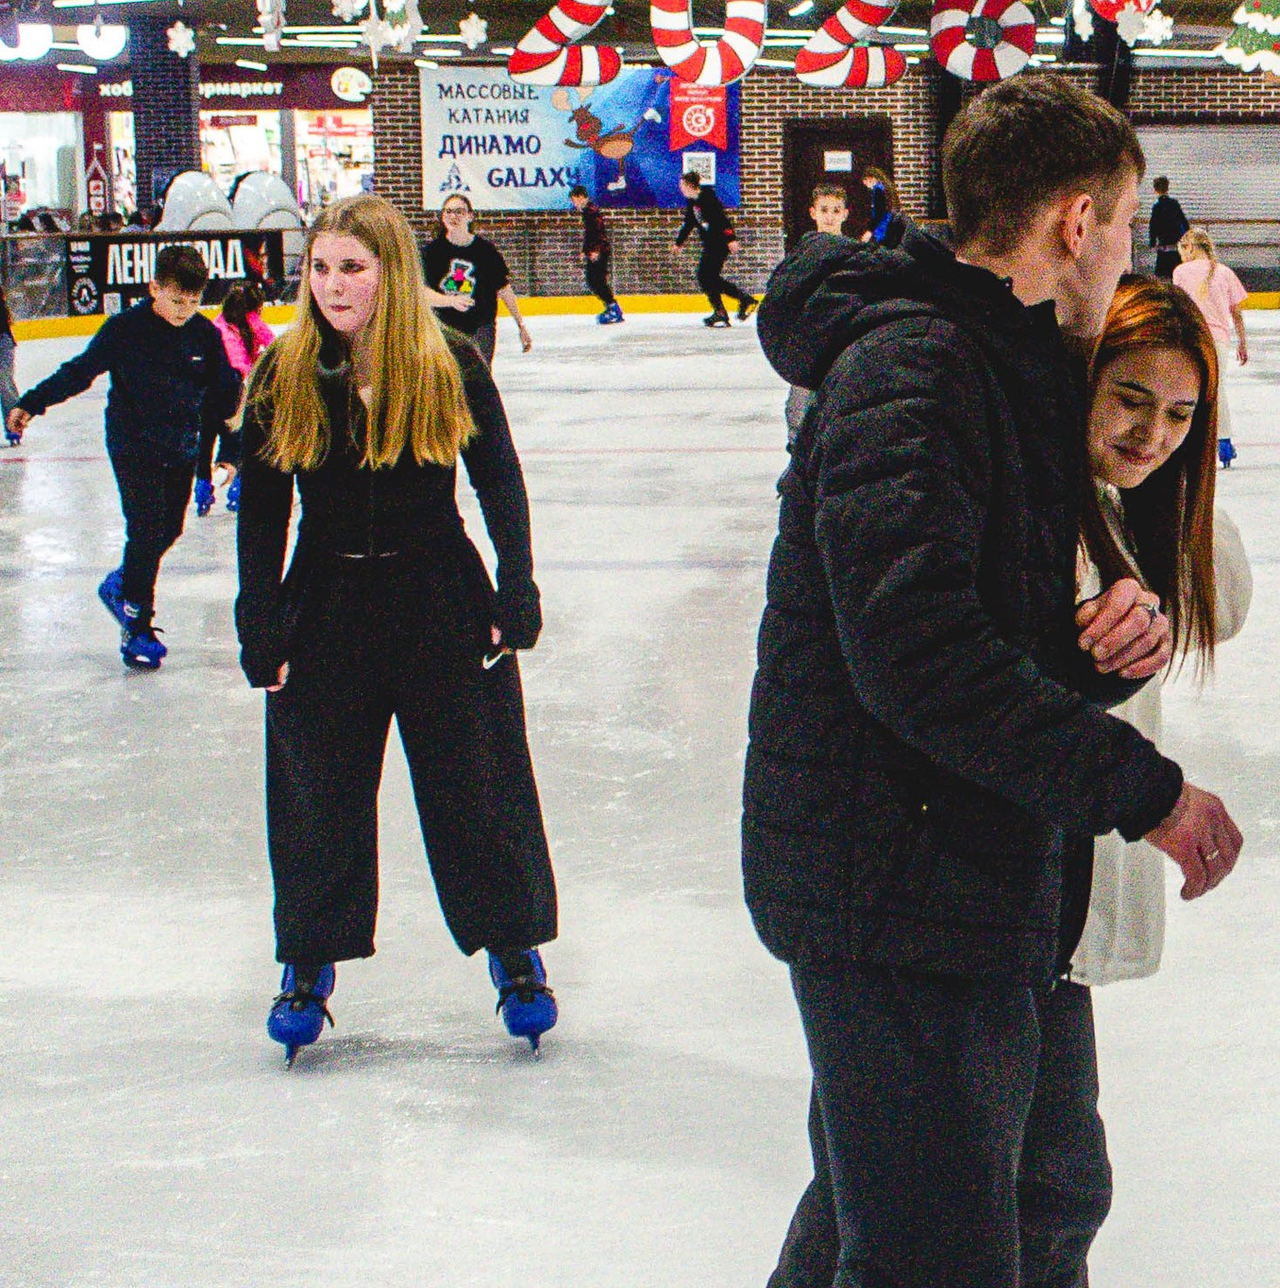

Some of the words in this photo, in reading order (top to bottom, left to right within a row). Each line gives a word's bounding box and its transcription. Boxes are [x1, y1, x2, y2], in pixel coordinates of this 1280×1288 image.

[437, 83, 539, 100] МАССОВЫЕ
[448, 108, 530, 124] КАТАНИЯ
[438, 135, 541, 158] ДИНАМО
[487, 167, 580, 188] GALAXY
[106, 239, 247, 285] ЛЕНАД
